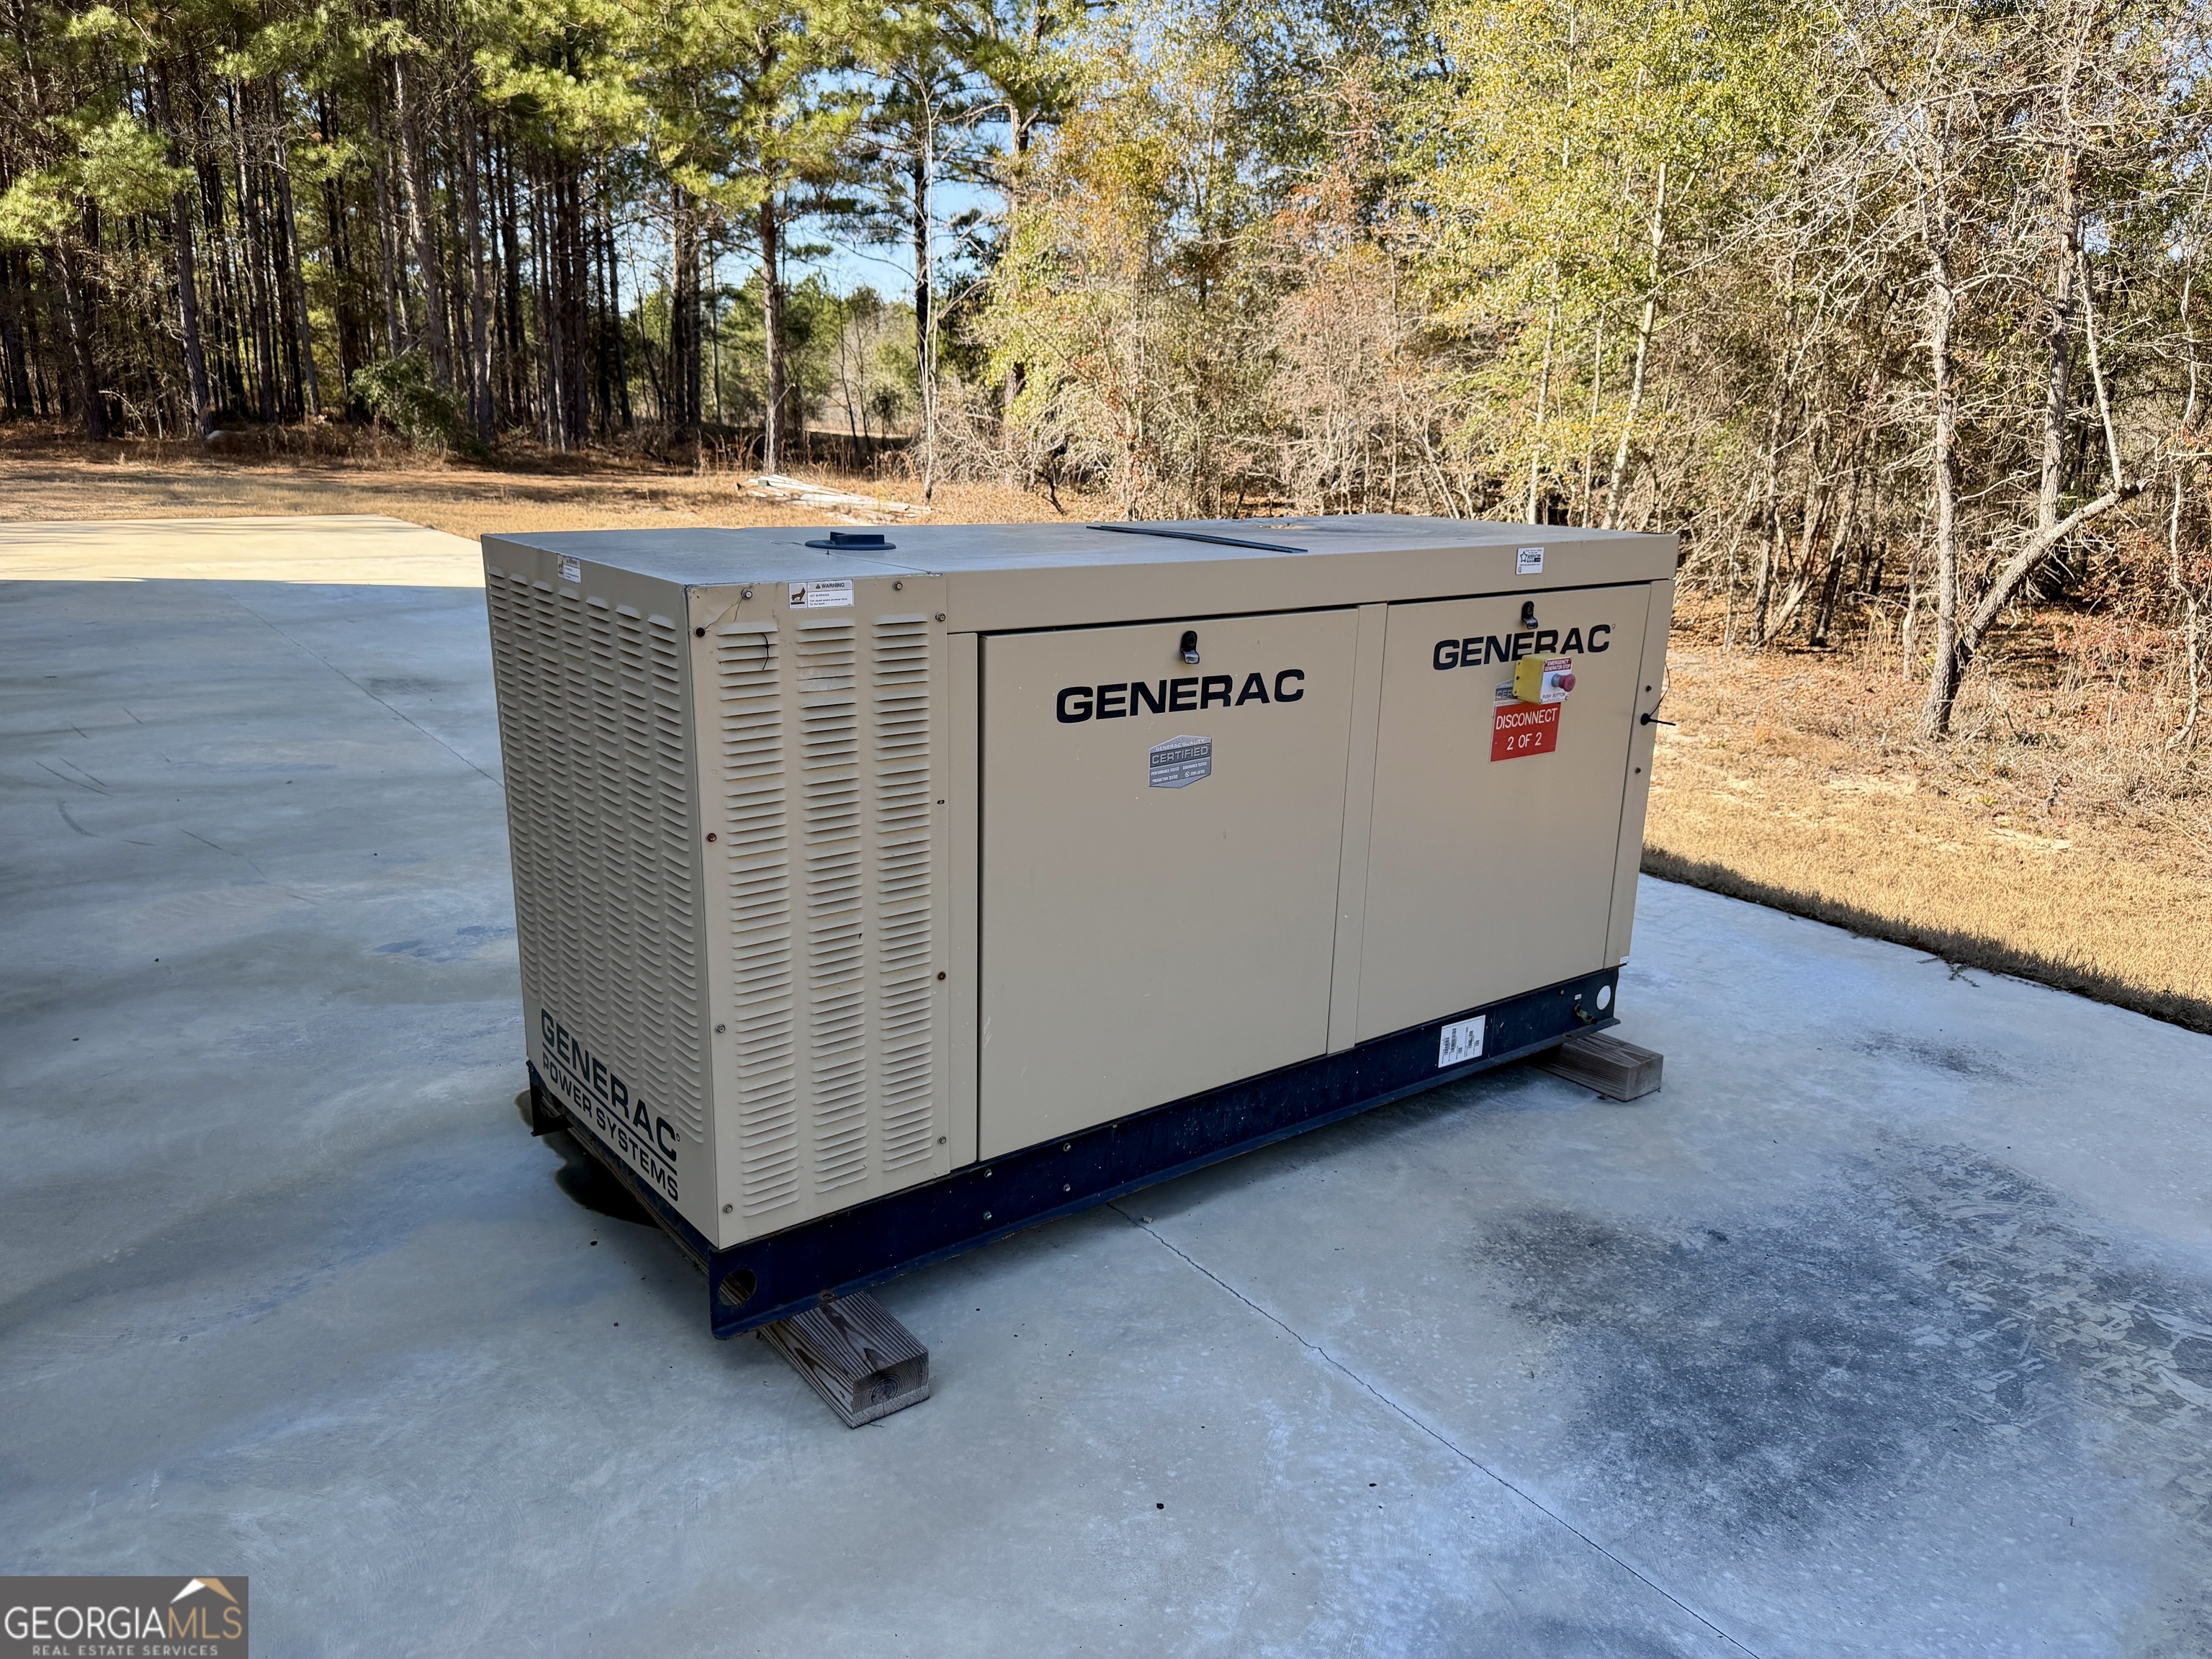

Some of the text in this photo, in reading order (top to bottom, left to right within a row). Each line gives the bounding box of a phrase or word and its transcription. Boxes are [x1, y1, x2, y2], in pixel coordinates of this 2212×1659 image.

[1434, 624, 1611, 670] GENERAC
[1056, 669, 1305, 724] GENERAC
[1496, 708, 1557, 730] DISCONNECT
[1152, 746, 1208, 764] CERTIFIED
[1156, 742, 1181, 751] GENERAC
[1506, 732, 1542, 750] 2 OF 2
[541, 1008, 678, 1162] GENERAC
[543, 1051, 678, 1202] POWER SYSTEMS
